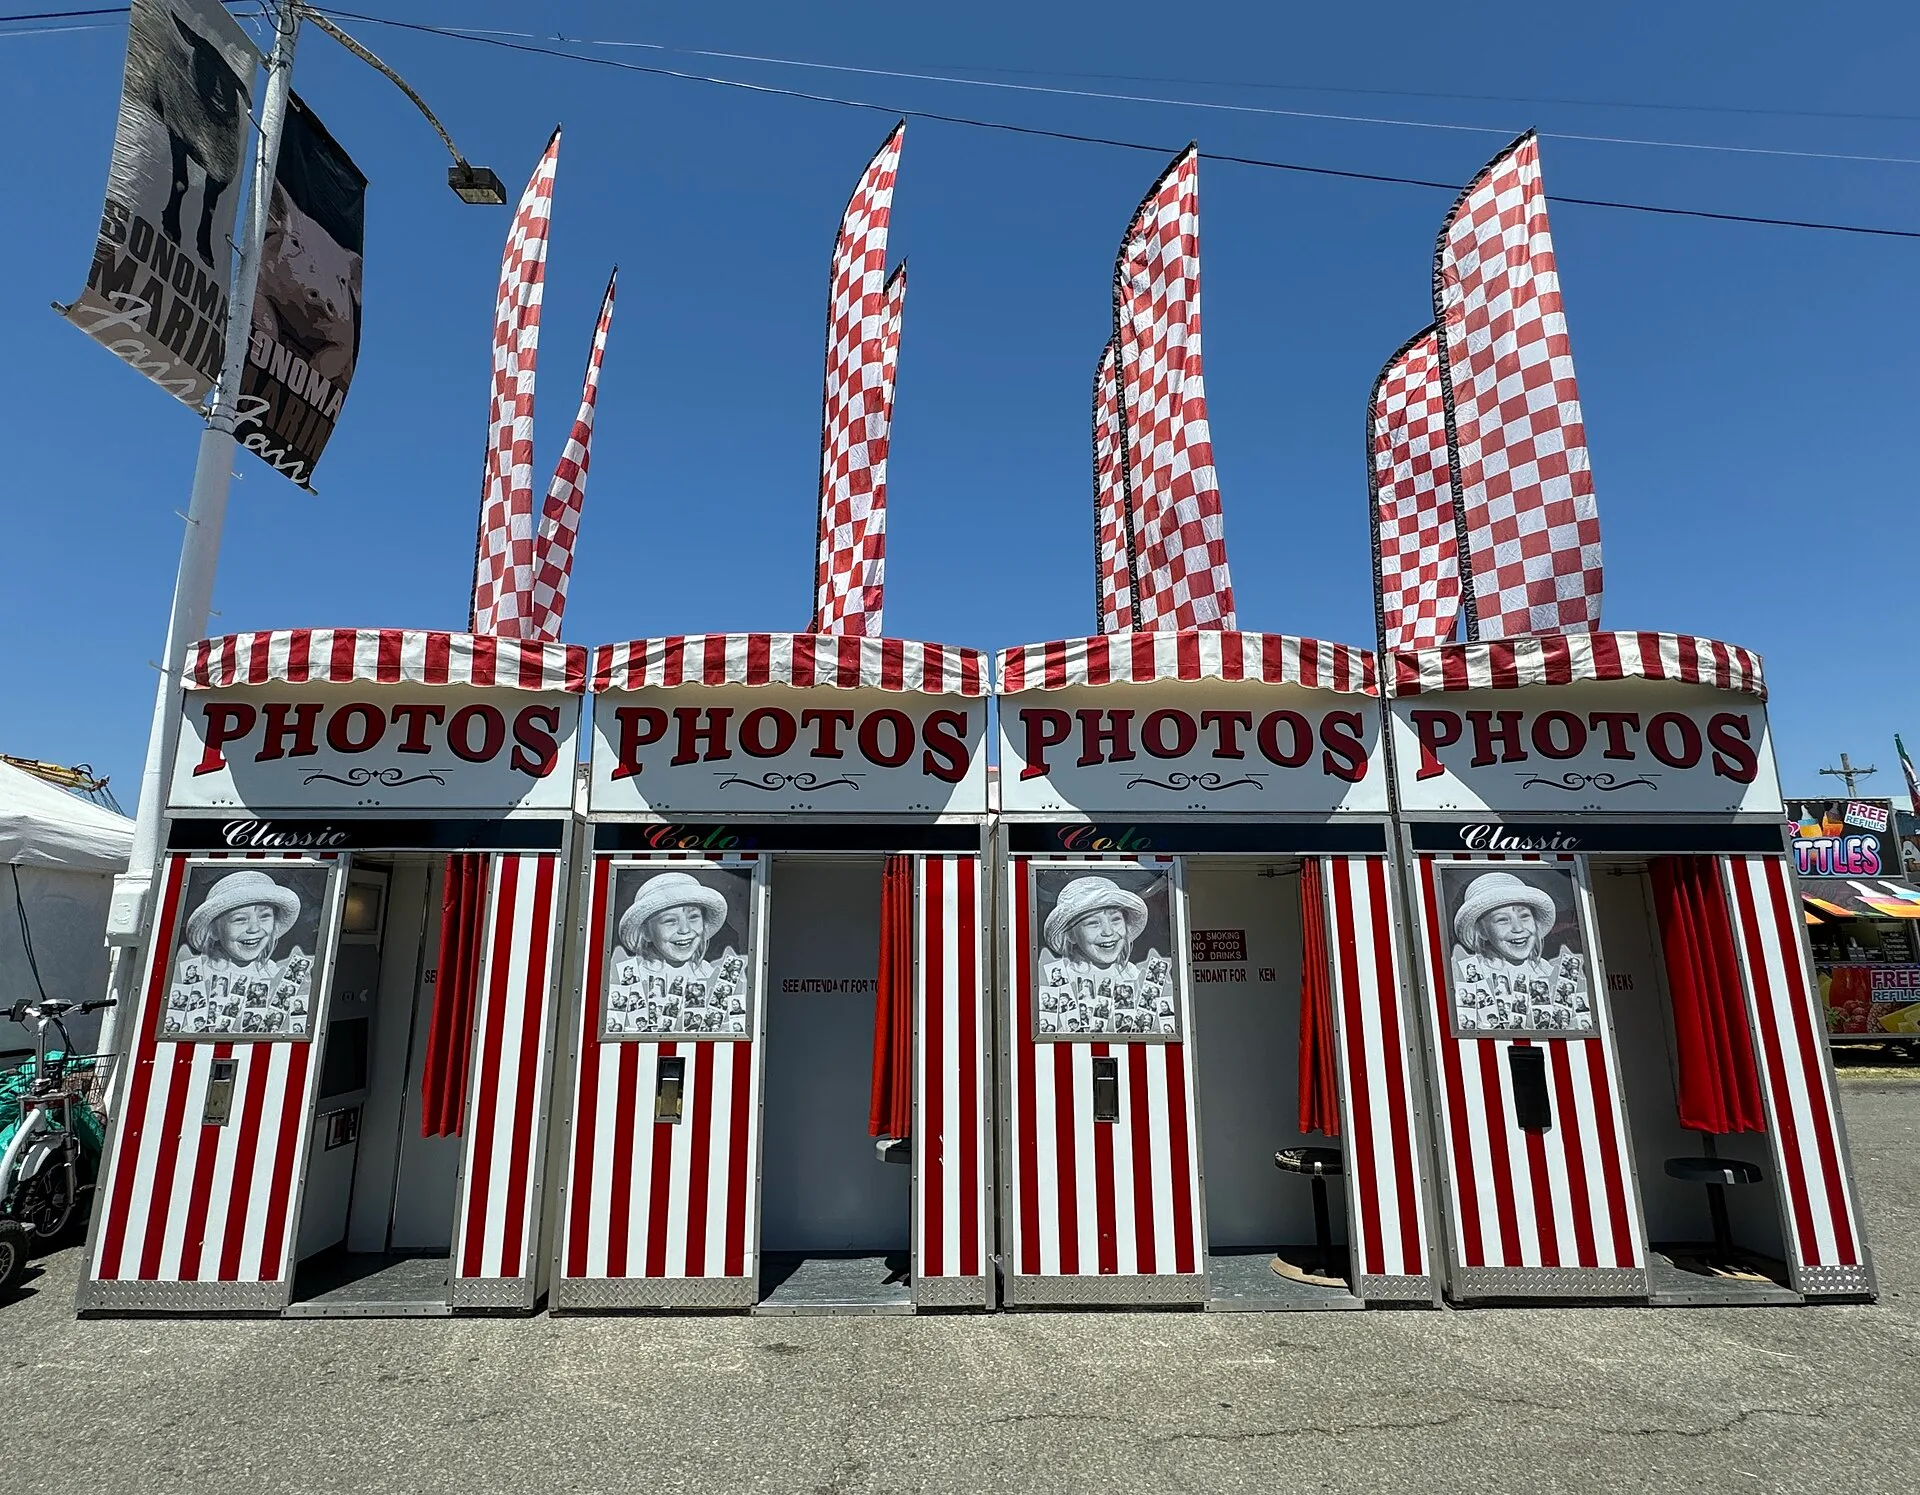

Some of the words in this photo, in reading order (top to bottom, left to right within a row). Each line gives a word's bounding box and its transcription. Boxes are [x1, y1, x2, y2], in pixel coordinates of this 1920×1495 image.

[99, 198, 229, 335] SONOMA
[87, 241, 226, 380] MARIN
[250, 330, 344, 424] ONOMA
[193, 702, 560, 778] PHOTOS
[611, 706, 970, 783] PHOTOS
[1019, 708, 1369, 783] PHOTOS
[1410, 710, 1758, 784] PHOTOS
[1845, 815, 1887, 832] REFILLS
[1847, 802, 1888, 823] FREE
[222, 820, 351, 847] Classic
[644, 823, 752, 850] Colo
[1057, 824, 1160, 852] Colo
[1459, 823, 1582, 851] Classic
[1793, 836, 1881, 875] TTLES
[1191, 932, 1202, 941] NO
[1206, 931, 1240, 941] SMOKING
[1192, 942, 1206, 951] NO
[1213, 941, 1240, 950] FOOD
[1192, 952, 1205, 961] NO
[1210, 951, 1242, 960] DRINKS
[424, 969, 437, 984] SE
[782, 979, 799, 993] SEE
[800, 979, 850, 993] ATTENDANT
[851, 979, 868, 993] FOR
[1193, 968, 1228, 983] ENDANT
[1229, 968, 1247, 982] FOR
[1871, 970, 1920, 989] FREE
